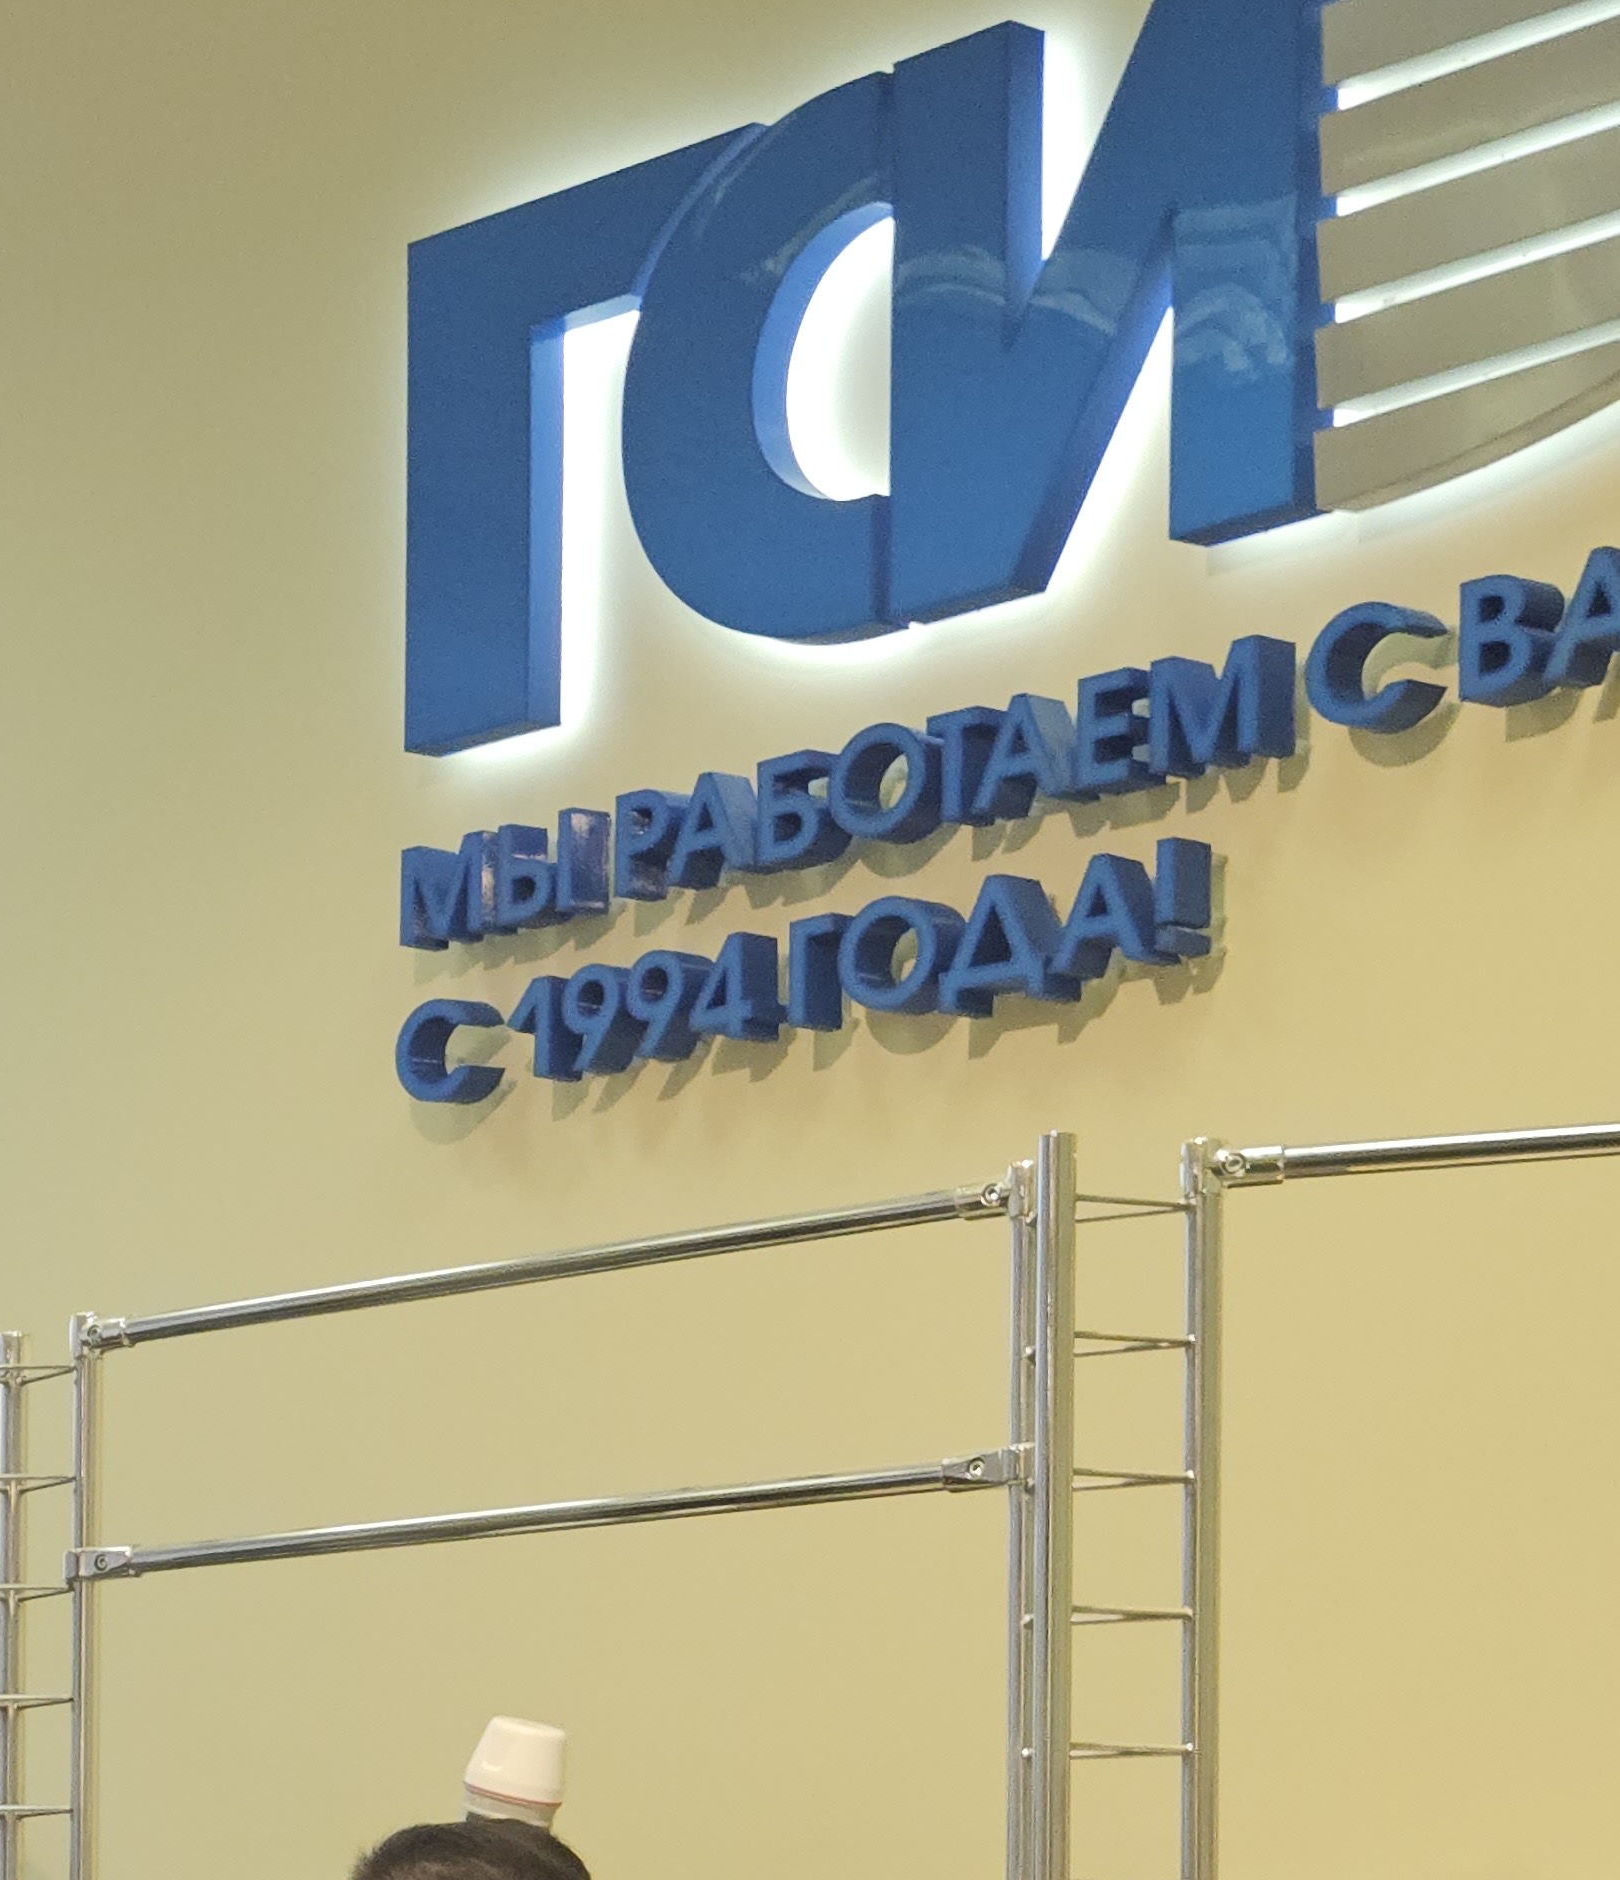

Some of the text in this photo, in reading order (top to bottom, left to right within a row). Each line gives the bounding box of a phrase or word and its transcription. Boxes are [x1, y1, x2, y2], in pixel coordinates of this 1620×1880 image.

[404, 0, 1318, 756] ГСИ
[401, 806, 610, 950] МЫ
[616, 633, 1296, 902] РАБОТАЕМ
[1306, 601, 1447, 735] С
[395, 837, 1213, 1104] С 1994 ГОДА!
